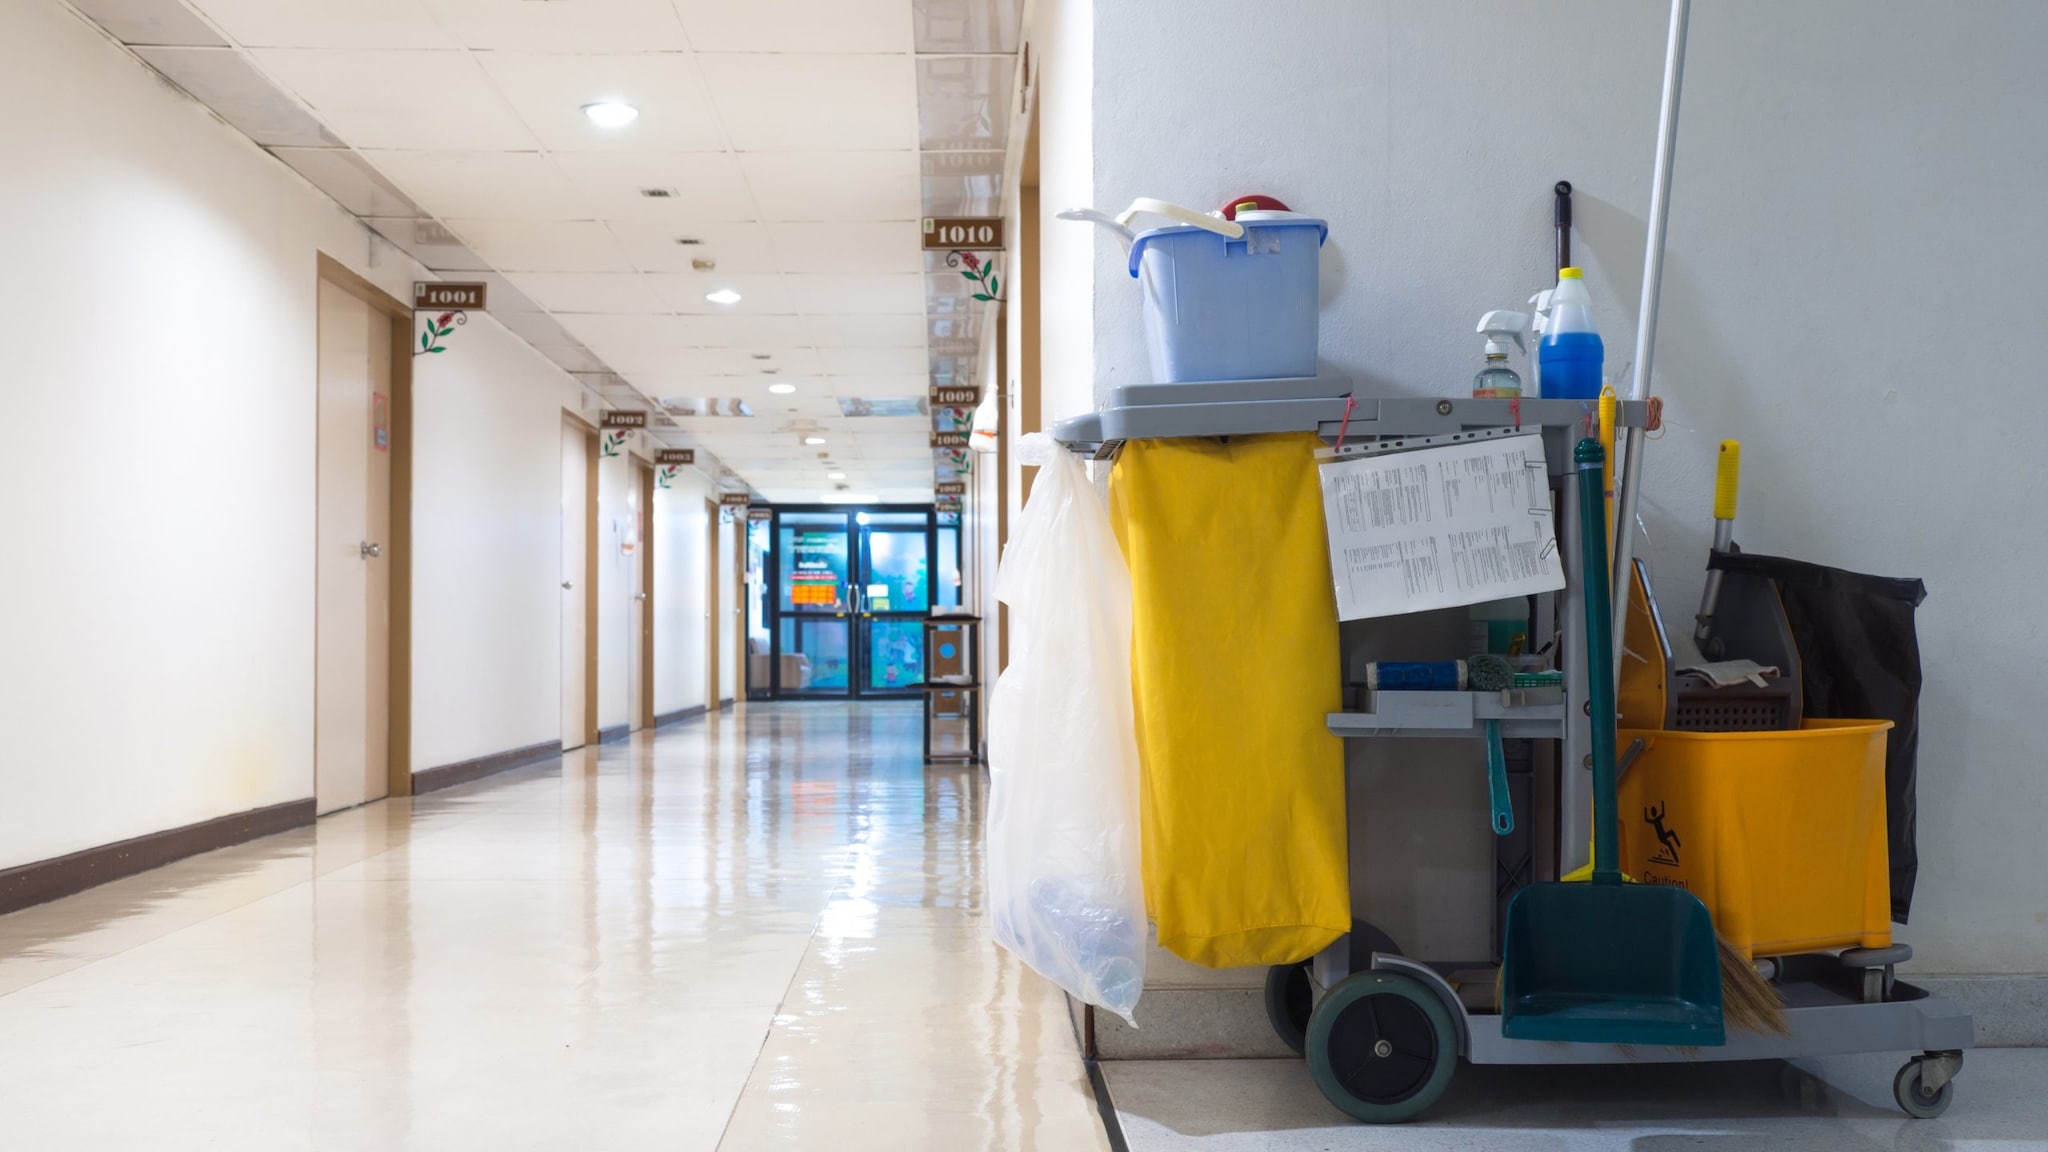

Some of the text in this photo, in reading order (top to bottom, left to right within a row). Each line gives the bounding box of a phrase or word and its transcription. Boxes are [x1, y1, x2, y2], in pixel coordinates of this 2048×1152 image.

[938, 225, 994, 244] 1010
[429, 290, 477, 304] 1001
[939, 391, 975, 402] 1009
[609, 415, 643, 425] 1002
